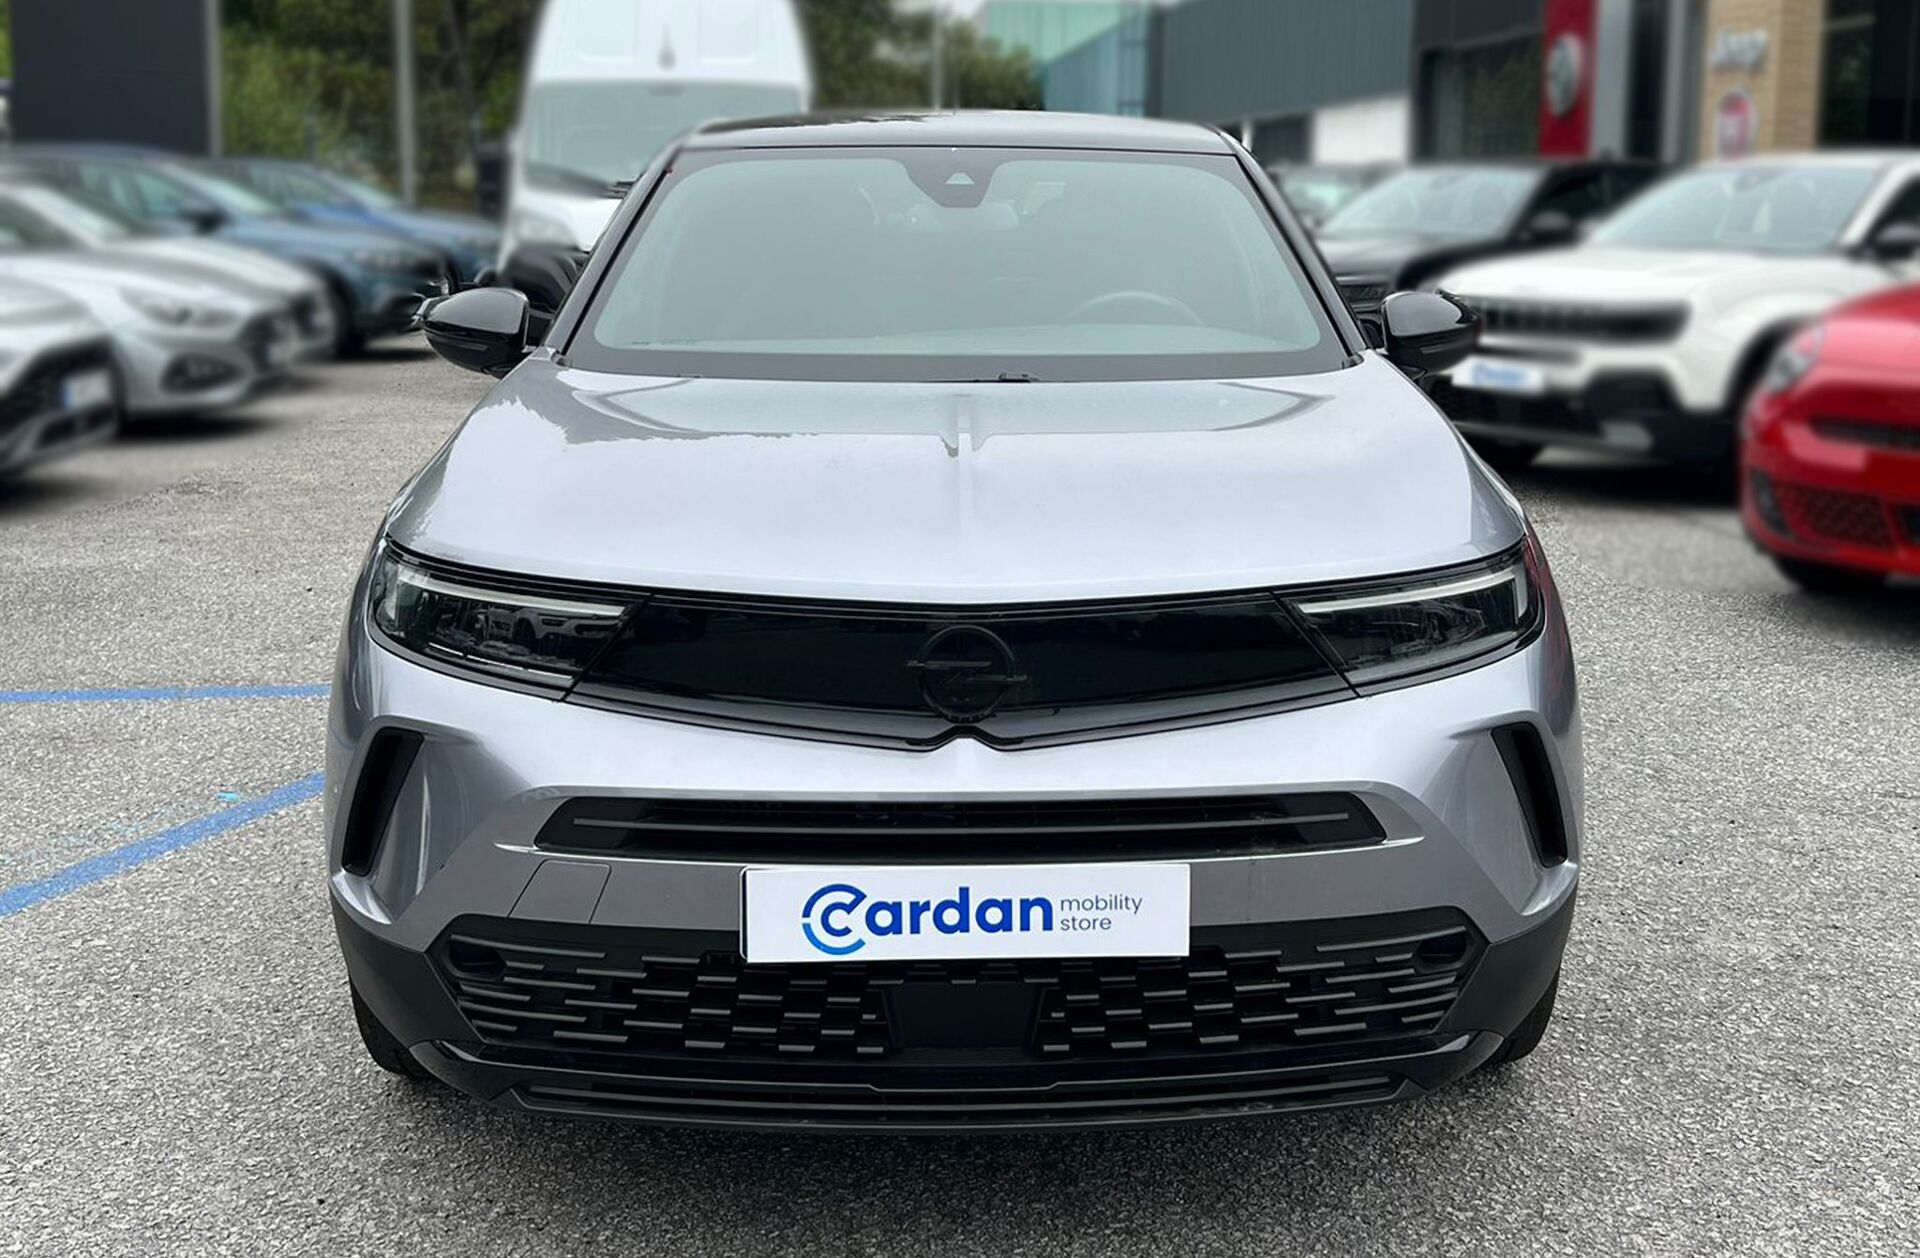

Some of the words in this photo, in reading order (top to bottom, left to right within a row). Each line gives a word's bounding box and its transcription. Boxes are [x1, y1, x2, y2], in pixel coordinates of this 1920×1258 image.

[1060, 893, 1143, 914] mobility
[802, 883, 1053, 955] Cardan
[1060, 915, 1112, 932] store
